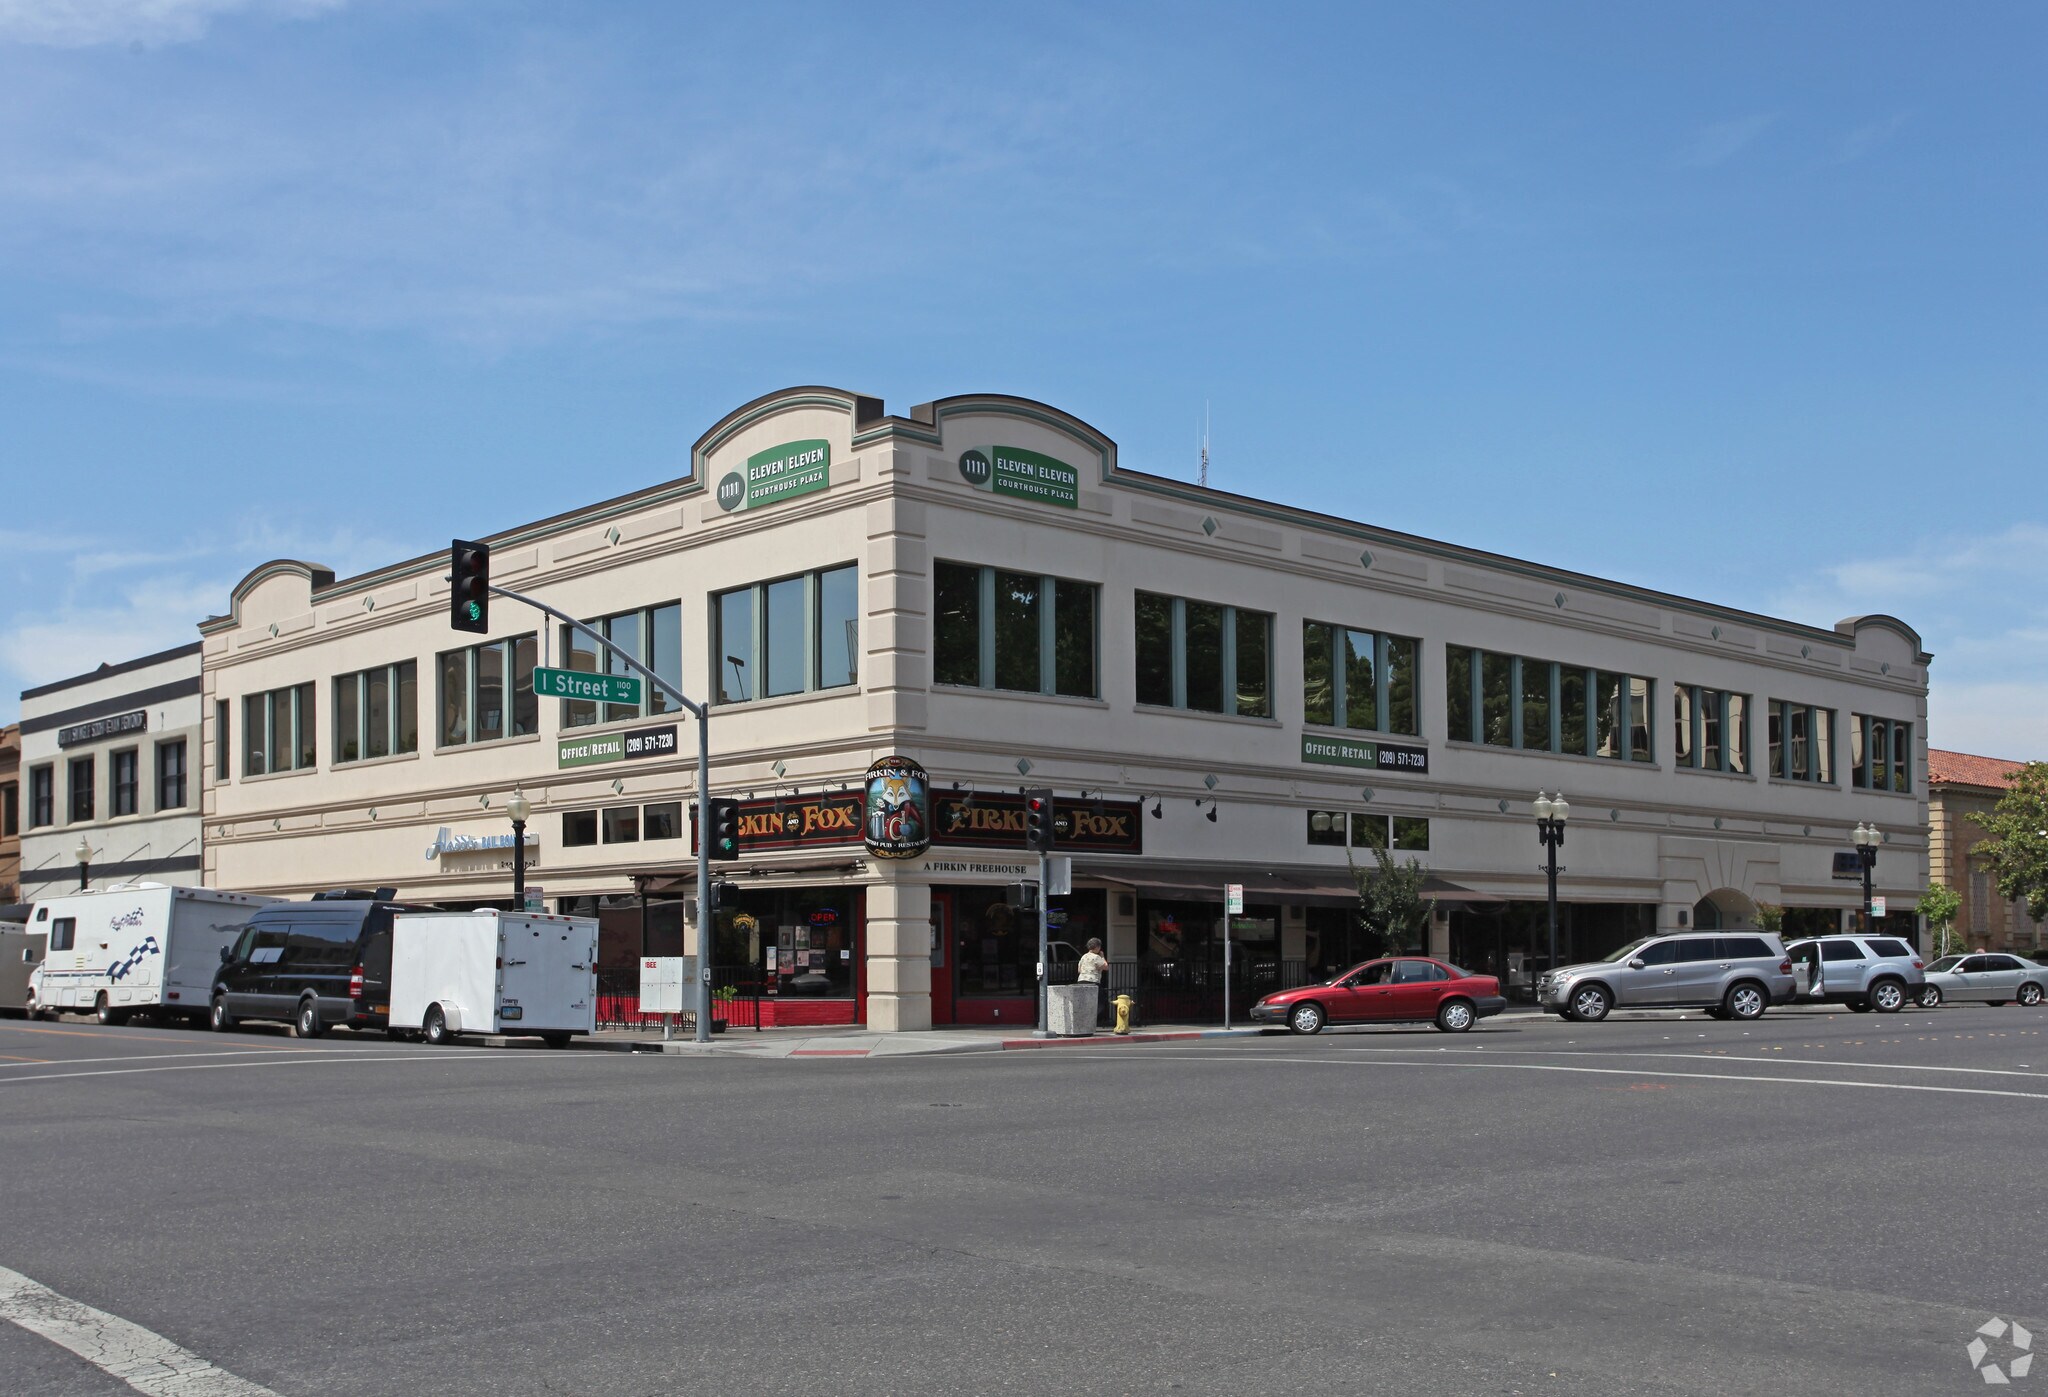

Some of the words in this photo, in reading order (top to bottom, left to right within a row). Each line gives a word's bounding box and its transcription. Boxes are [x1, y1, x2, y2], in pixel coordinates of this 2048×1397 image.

[750, 460, 784, 480] ELEVEN
[789, 448, 824, 470] ELEVEN
[966, 459, 985, 476] 1111
[997, 458, 1034, 475] ELEVEN
[1039, 466, 1074, 484] ELEVEN
[721, 481, 739, 499] 1111
[751, 479, 797, 499] COURTHOUSE
[801, 472, 823, 485] PLAZA
[998, 479, 1048, 495] COURTHOUSE
[1051, 489, 1074, 500] PLAZA
[543, 673, 546, 690] I
[556, 675, 608, 697] Street
[616, 681, 631, 690] 1100
[627, 737, 642, 753] (209)
[645, 733, 673, 750] 571-7230
[1380, 750, 1395, 764] (209)
[1398, 752, 1425, 767] 571-7230
[865, 769, 896, 781] FIRKIN
[911, 770, 928, 781] FOX
[801, 805, 856, 836] FOX
[1070, 811, 1129, 839] FOX
[481, 836, 499, 849] BAIL
[924, 863, 931, 871] A
[934, 863, 967, 872] FIRKIN
[970, 864, 1027, 874] FREEHOUSE
[811, 913, 836, 921] OPEN
